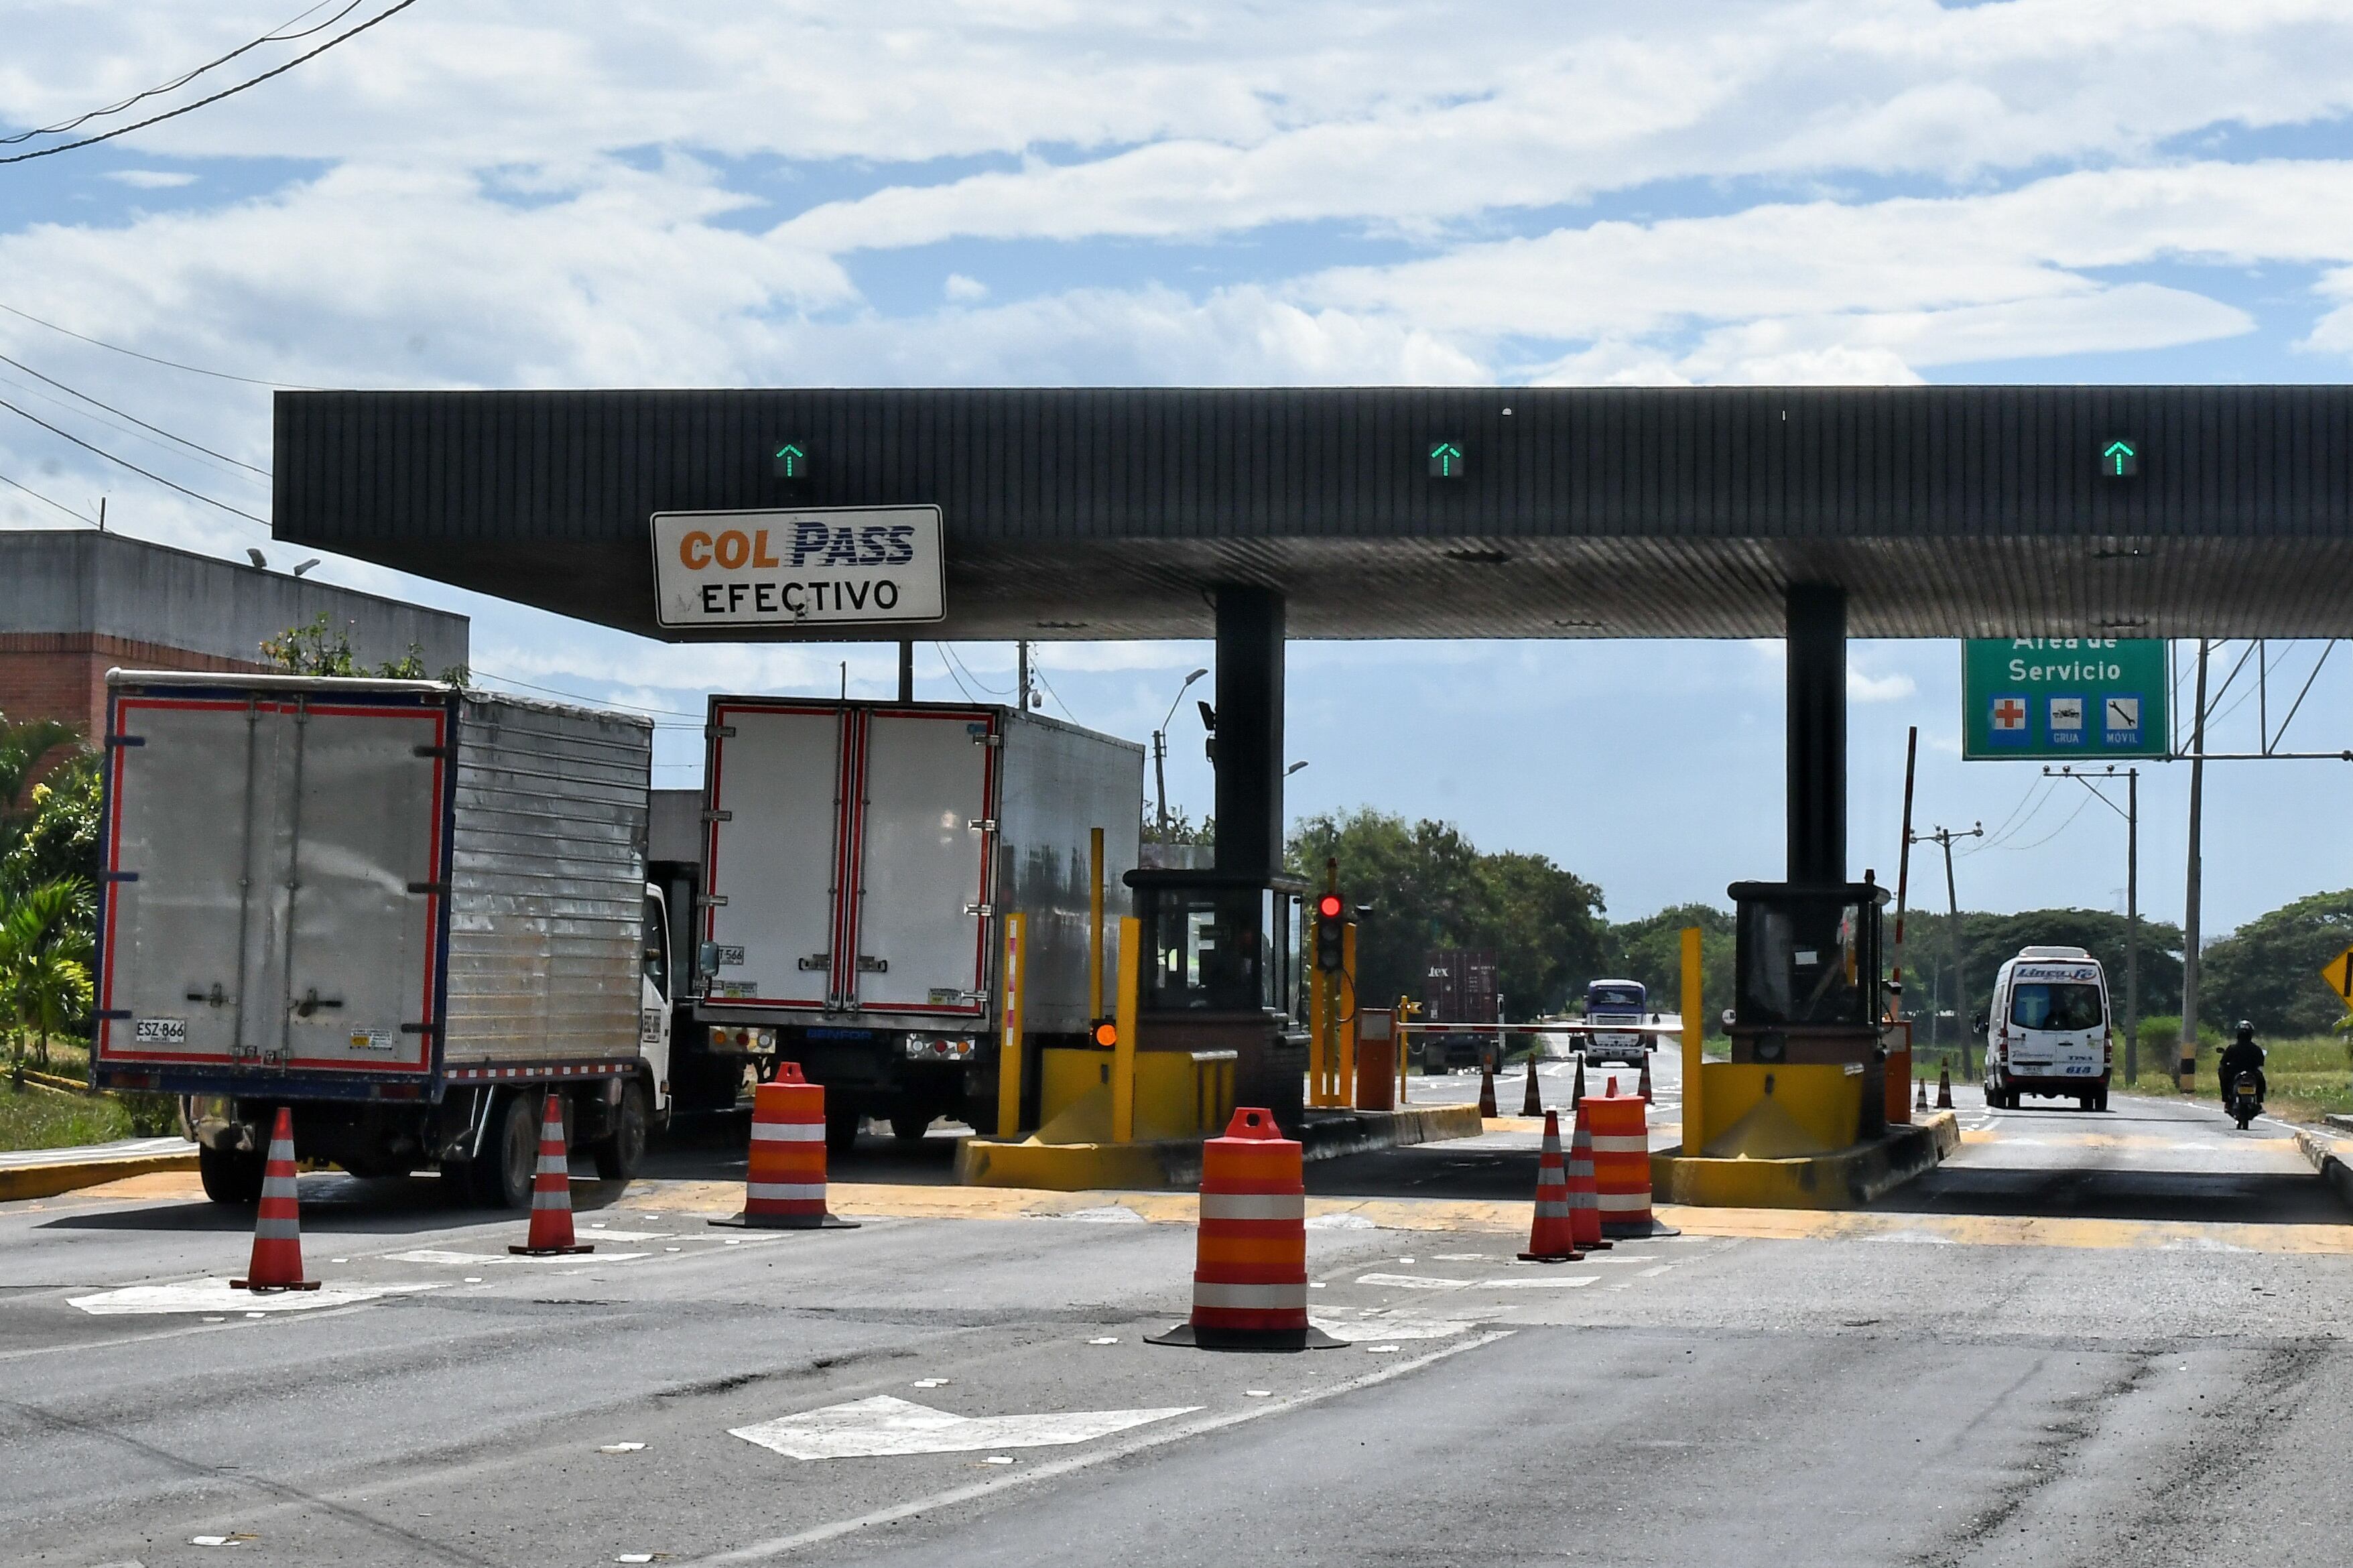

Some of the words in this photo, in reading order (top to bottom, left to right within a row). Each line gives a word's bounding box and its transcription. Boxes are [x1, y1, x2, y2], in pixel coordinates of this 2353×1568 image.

[680, 529, 779, 570] COL
[783, 521, 915, 567] PASS
[702, 580, 899, 612] EFECTIVO
[2009, 659, 2120, 681] Servicio
